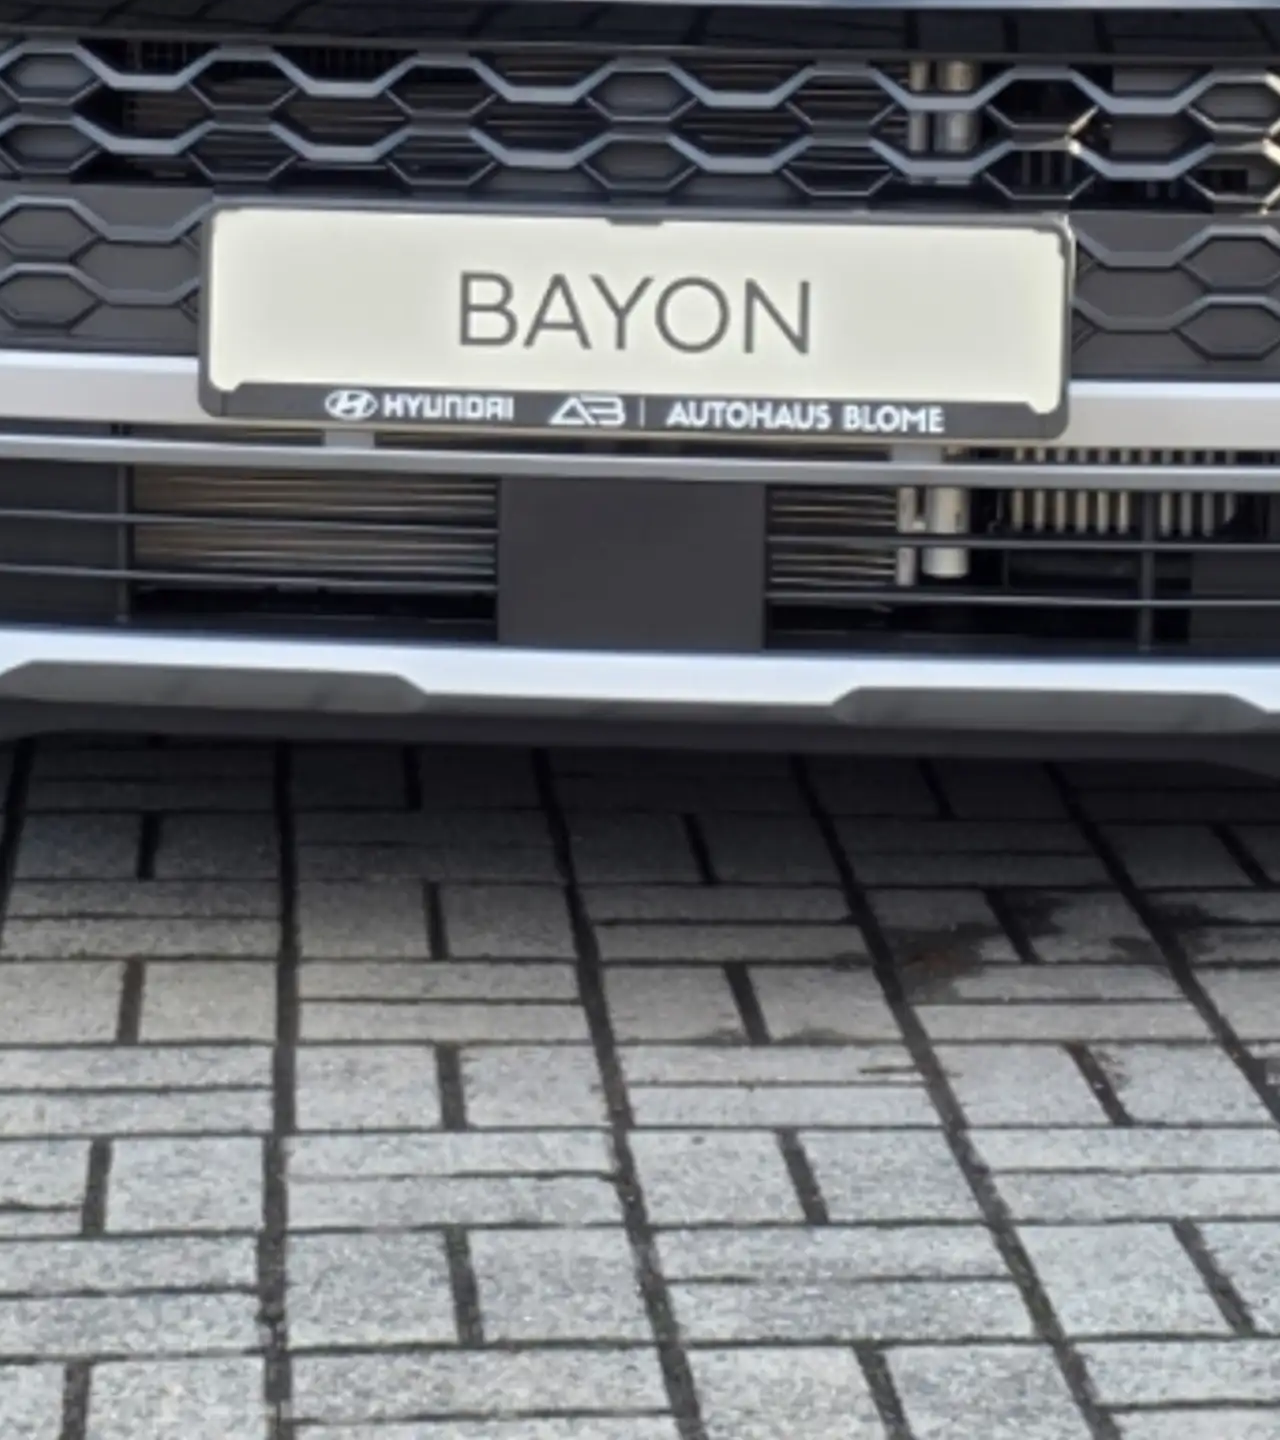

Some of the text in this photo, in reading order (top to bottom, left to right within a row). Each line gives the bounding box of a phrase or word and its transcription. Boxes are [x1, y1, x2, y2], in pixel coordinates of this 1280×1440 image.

[458, 270, 811, 356] BAYON
[383, 393, 515, 422] HYUNDAI
[665, 400, 832, 431] AUTOHAUS
[842, 403, 945, 434] BLOME
